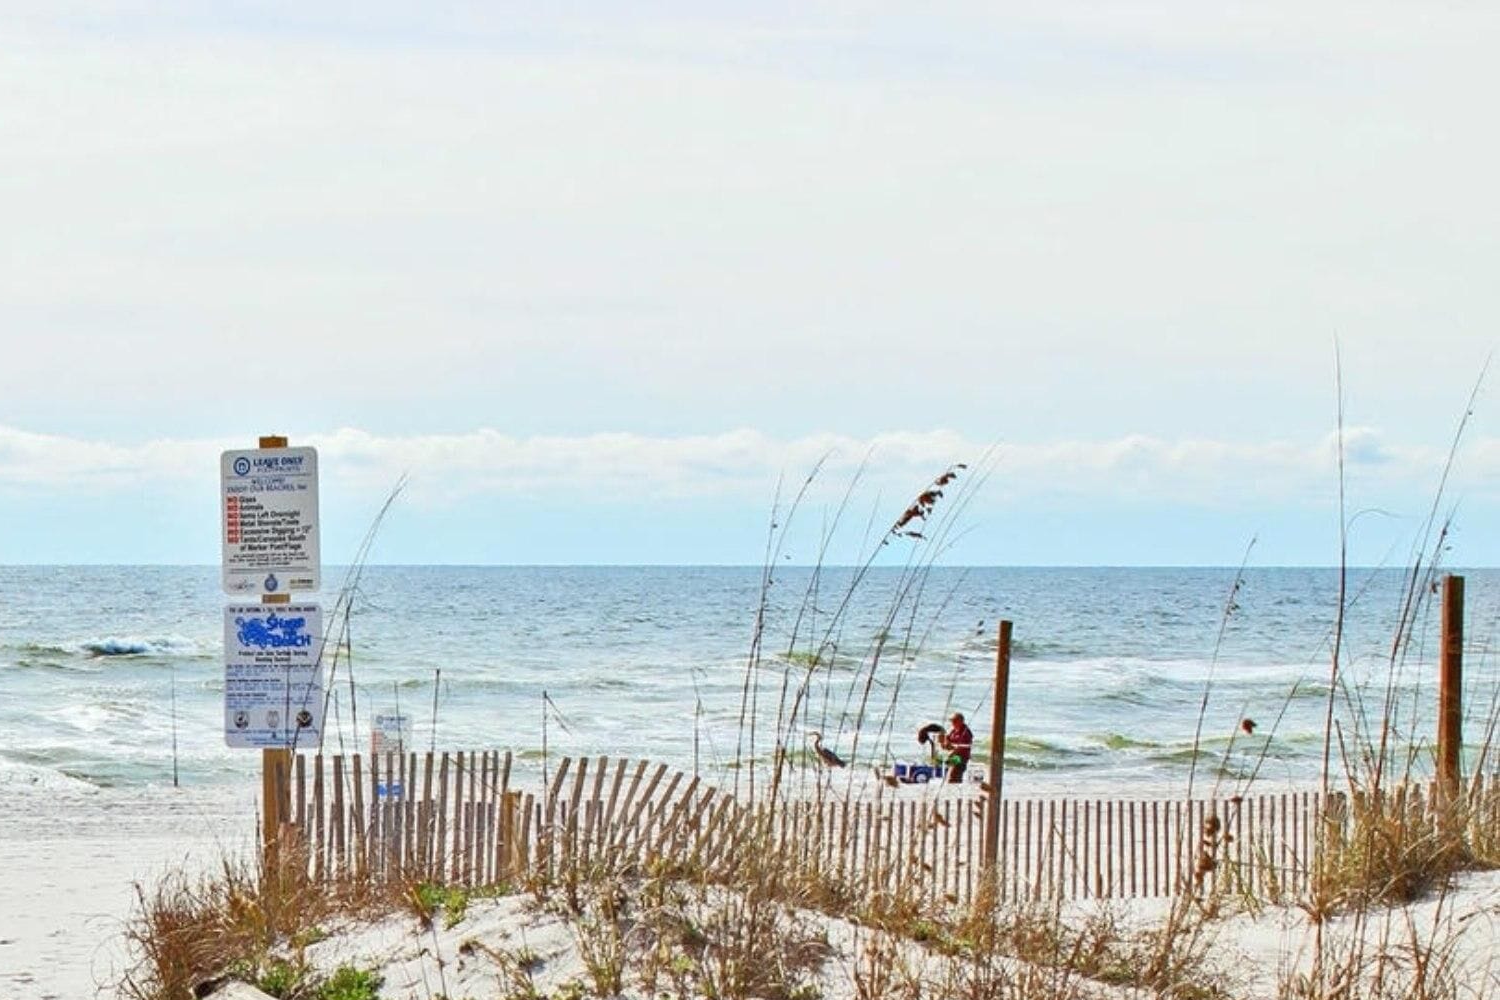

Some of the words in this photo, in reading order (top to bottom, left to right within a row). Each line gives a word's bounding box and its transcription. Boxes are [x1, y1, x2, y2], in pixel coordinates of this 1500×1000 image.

[254, 457, 279, 467] LEAVE
[281, 456, 304, 465] ONLY
[270, 511, 300, 519] Overnight
[272, 527, 294, 536] Digging
